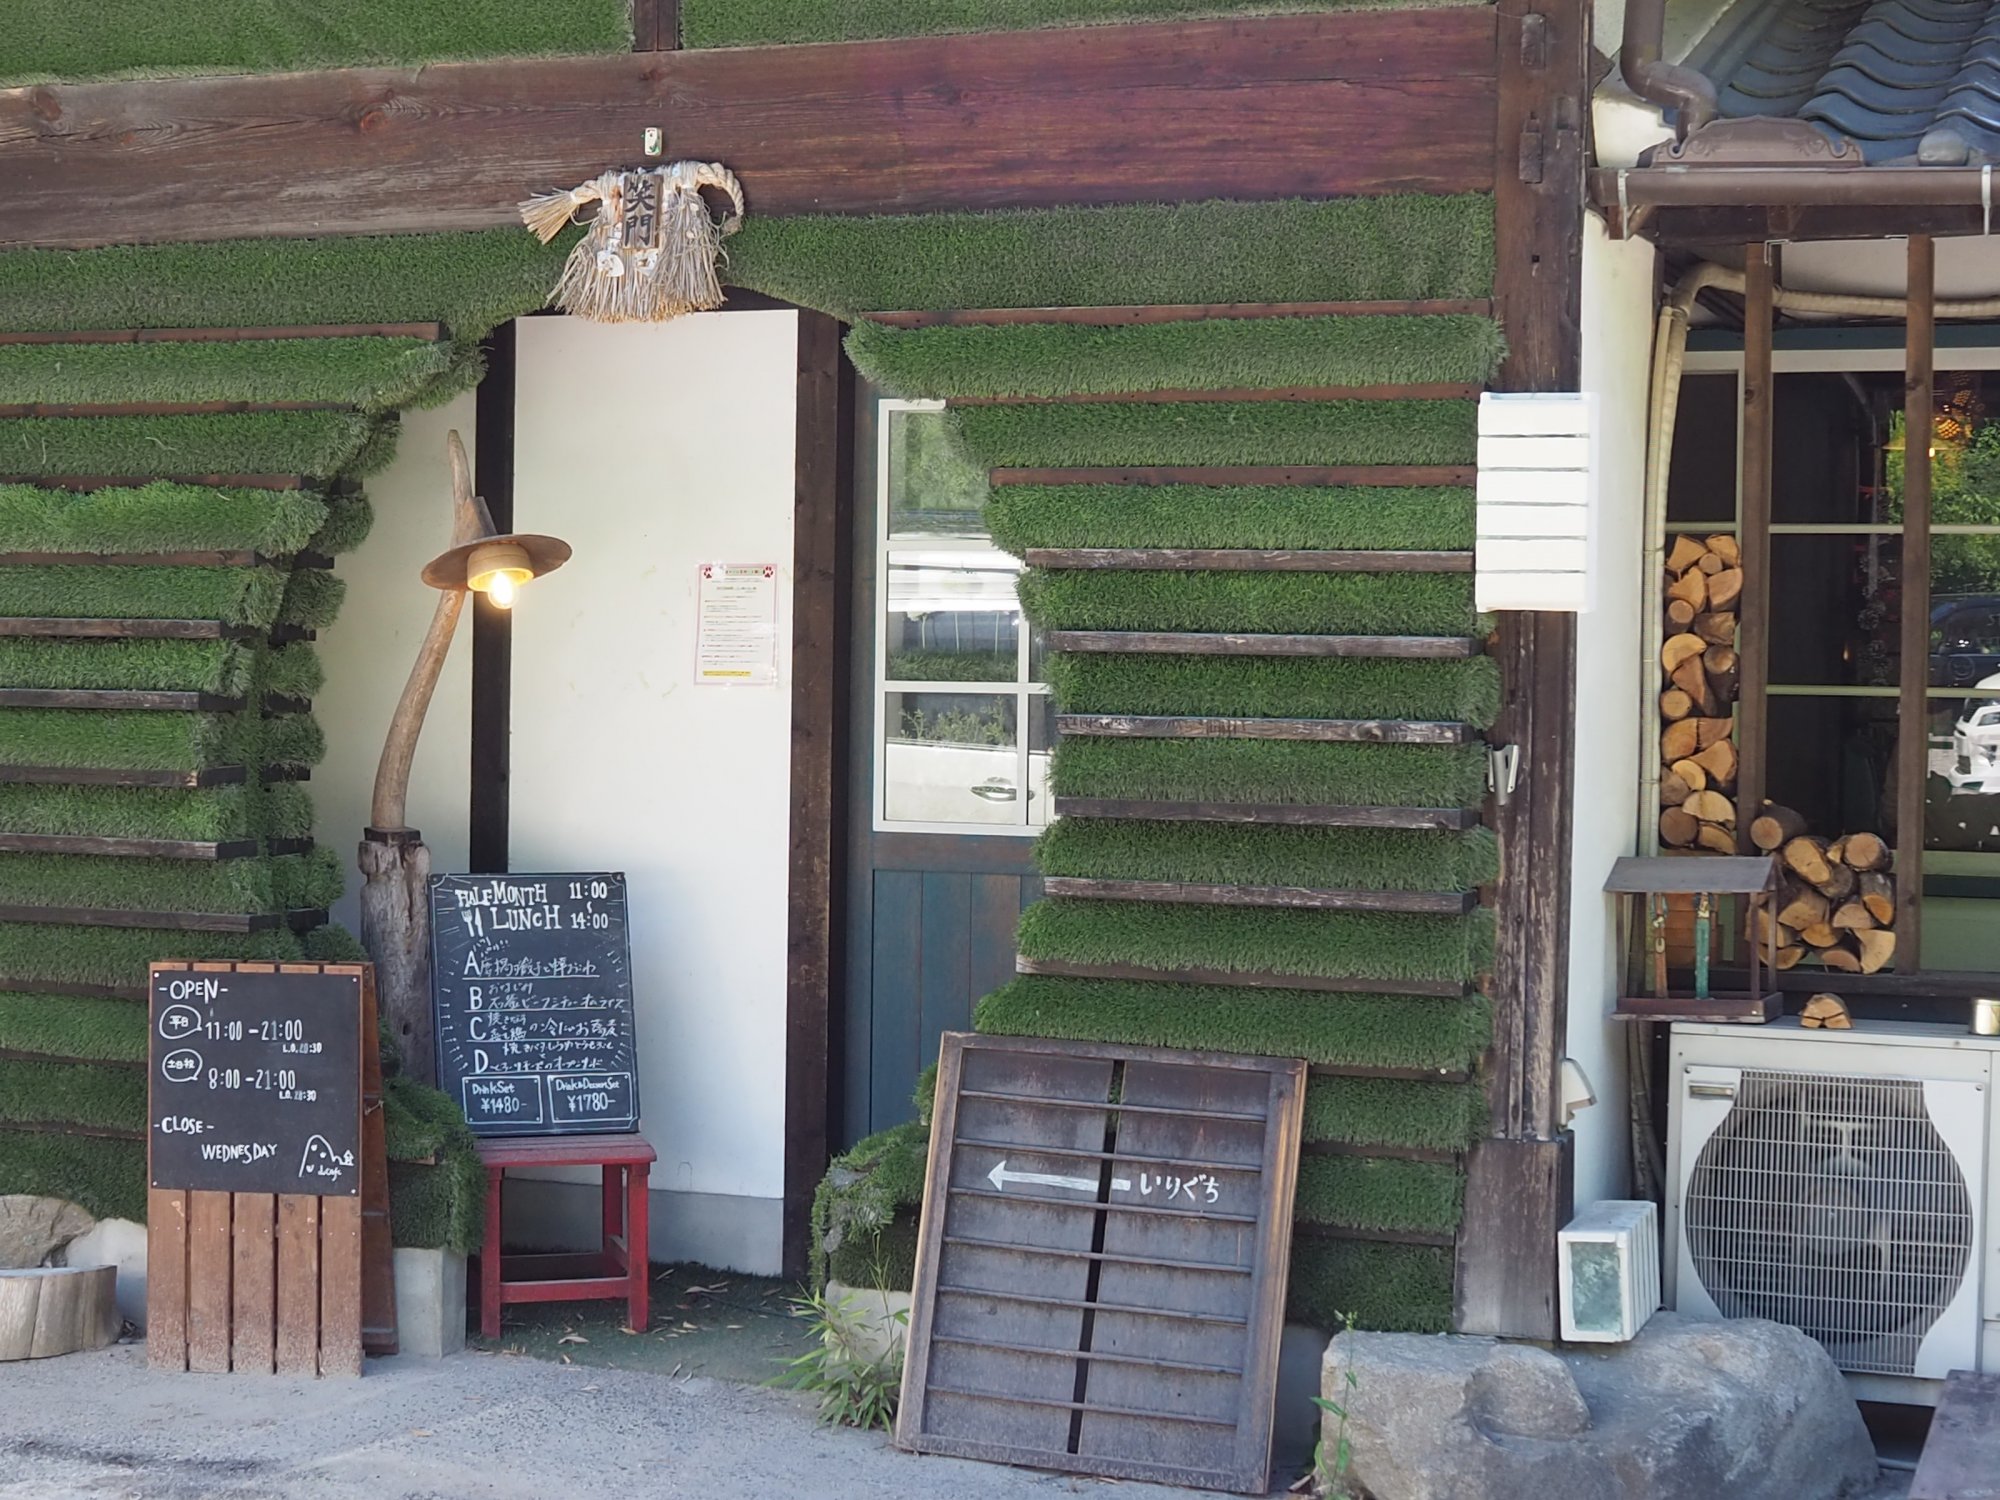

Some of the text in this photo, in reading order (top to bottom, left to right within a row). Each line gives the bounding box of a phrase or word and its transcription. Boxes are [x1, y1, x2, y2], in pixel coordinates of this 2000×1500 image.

[624, 178, 657, 248] 笑門
[568, 881, 608, 899] 11:00
[489, 904, 562, 931] LUNCH
[570, 912, 609, 929] 14:00
[469, 986, 483, 1010] B
[169, 1014, 189, 1030] 平日
[469, 1016, 487, 1040] C
[474, 1049, 489, 1074] D
[201, 1142, 278, 1165] WEDNESDAY
[1139, 1172, 1220, 1204] いりぐち
